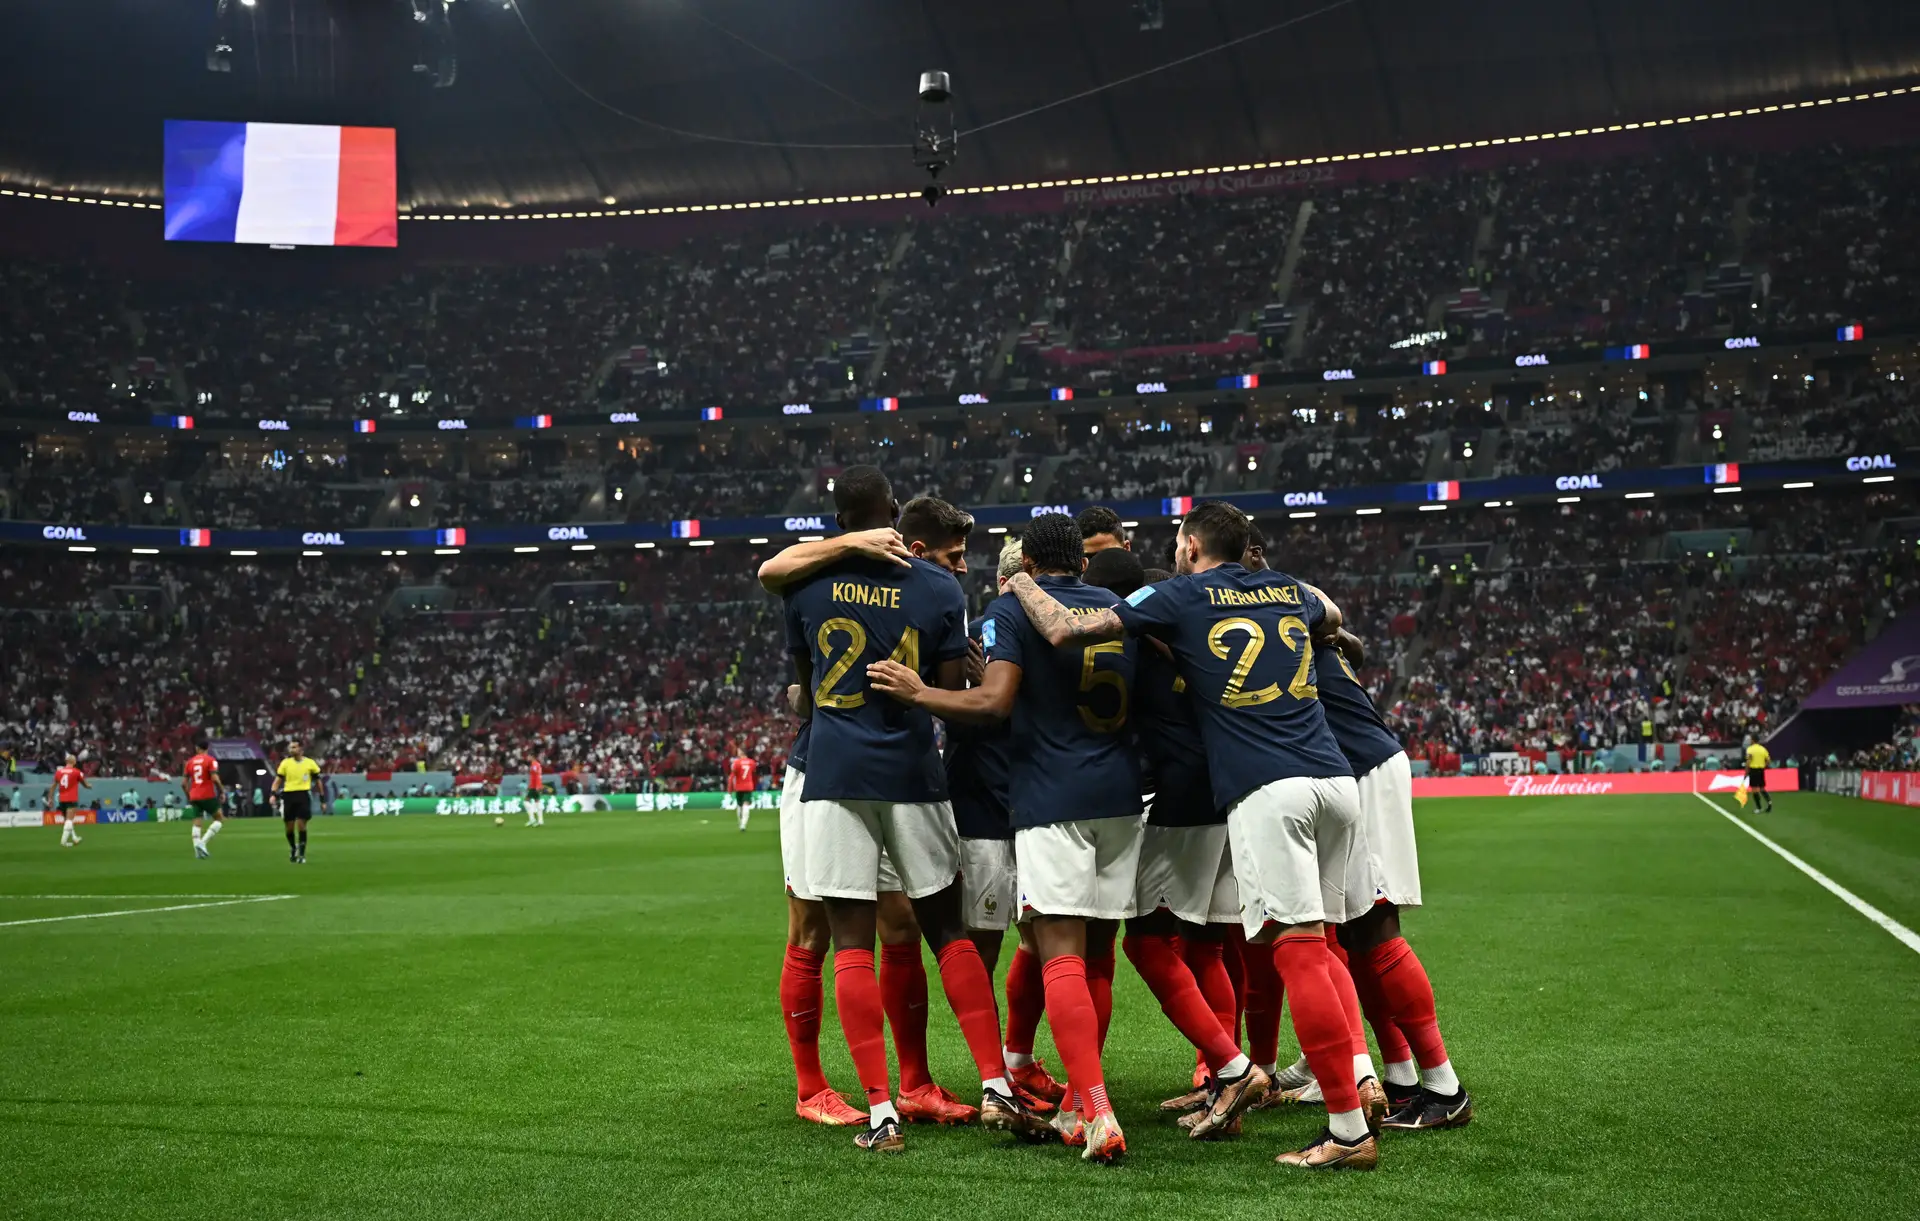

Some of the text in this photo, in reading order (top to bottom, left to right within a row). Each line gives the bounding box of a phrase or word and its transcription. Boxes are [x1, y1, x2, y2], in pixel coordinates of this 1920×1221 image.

[1100, 184, 1160, 200] WORLD
[1167, 180, 1200, 196] CUP
[1724, 336, 1760, 349] GOAL
[1515, 353, 1549, 367] GOAL
[1323, 368, 1355, 381] GOAL
[1136, 382, 1168, 394] GOAL
[958, 393, 989, 405] GOAL
[783, 403, 813, 415] GOAL
[68, 411, 100, 423] GOAL
[438, 419, 468, 430] GOAL
[610, 412, 639, 423] GOAL
[259, 419, 290, 431] GOAL
[1846, 454, 1897, 471] GOAL
[1555, 474, 1603, 491] GOAL
[1283, 491, 1328, 507] GOAL
[784, 516, 825, 532] GOAL
[43, 525, 87, 541] GOAL
[302, 531, 345, 546] GOAL
[548, 526, 589, 541] GOAL
[832, 582, 901, 609] KONATE
[1205, 585, 1302, 606] T.HERNANDEZ
[1207, 615, 1318, 709] 22
[1077, 640, 1128, 732] 5
[193, 765, 203, 784] 2
[741, 765, 750, 780] 7
[60, 773, 69, 789] 4
[1504, 775, 1613, 796] Budweiser
